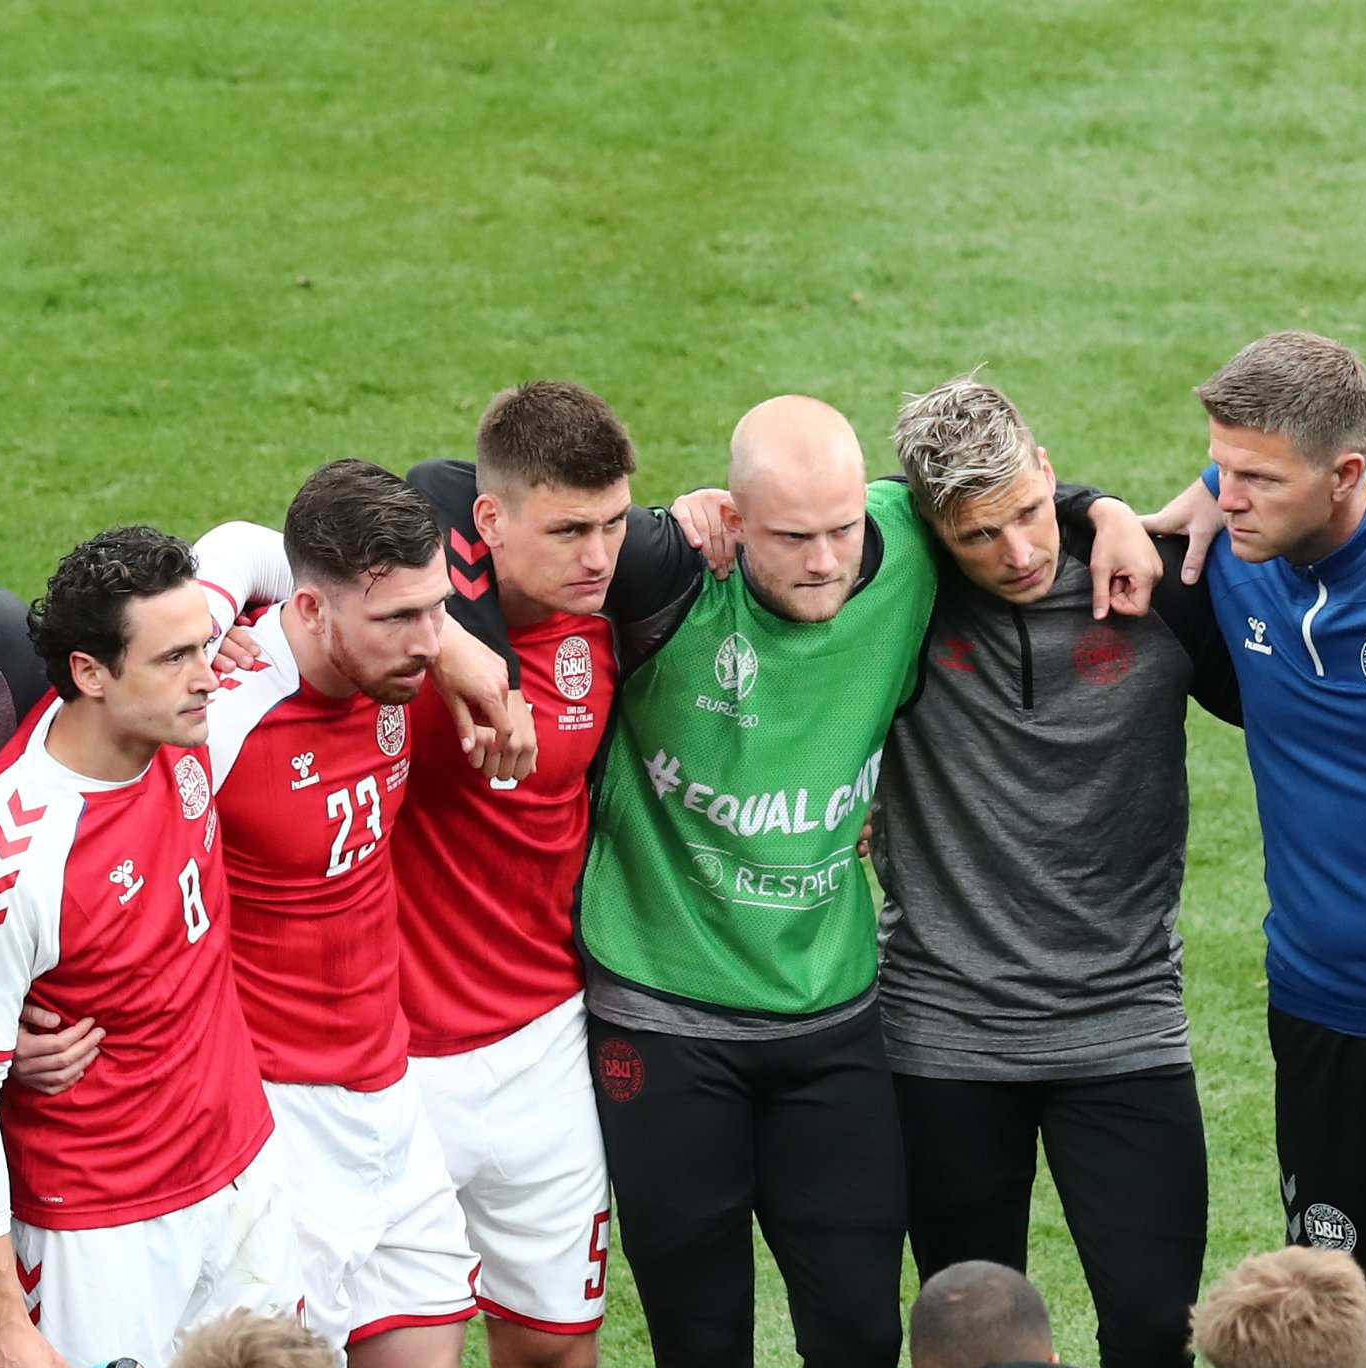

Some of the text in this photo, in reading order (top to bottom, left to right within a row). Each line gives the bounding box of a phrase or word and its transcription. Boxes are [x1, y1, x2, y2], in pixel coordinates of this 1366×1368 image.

[1244, 637, 1272, 655] hummel
[562, 657, 586, 677] DBU
[383, 709, 401, 738] DBU
[178, 768, 198, 804] DBU
[291, 771, 320, 791] hummel
[325, 775, 383, 878] 23
[118, 874, 145, 905] hummel
[736, 857, 851, 899] RESPECT
[178, 857, 210, 943] 8
[604, 1060, 632, 1078] DBU
[1314, 1219, 1345, 1240] DBU
[585, 1210, 610, 1300] 5
